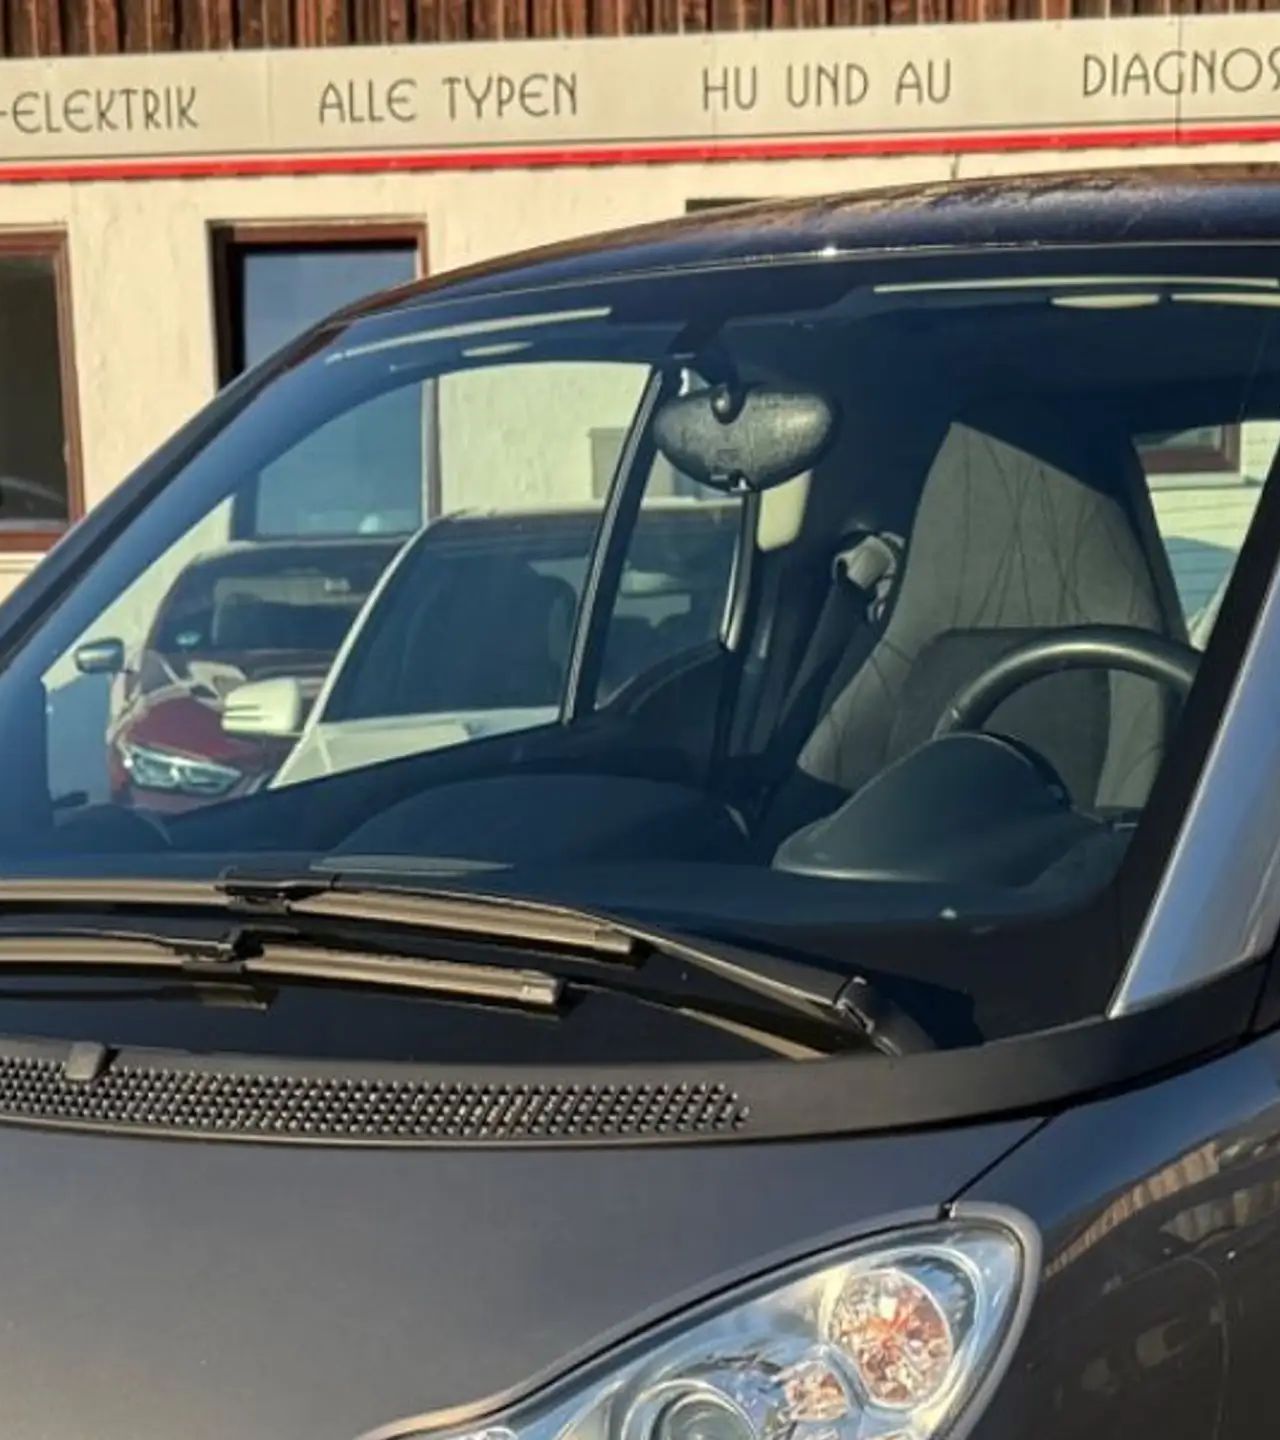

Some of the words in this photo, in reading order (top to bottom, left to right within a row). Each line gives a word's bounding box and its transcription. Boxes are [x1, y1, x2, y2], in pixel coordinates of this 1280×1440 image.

[318, 77, 418, 126] ALLE
[440, 71, 578, 123] TYPEN
[701, 64, 759, 113] HU
[784, 60, 871, 110] UND
[894, 57, 952, 107] AU
